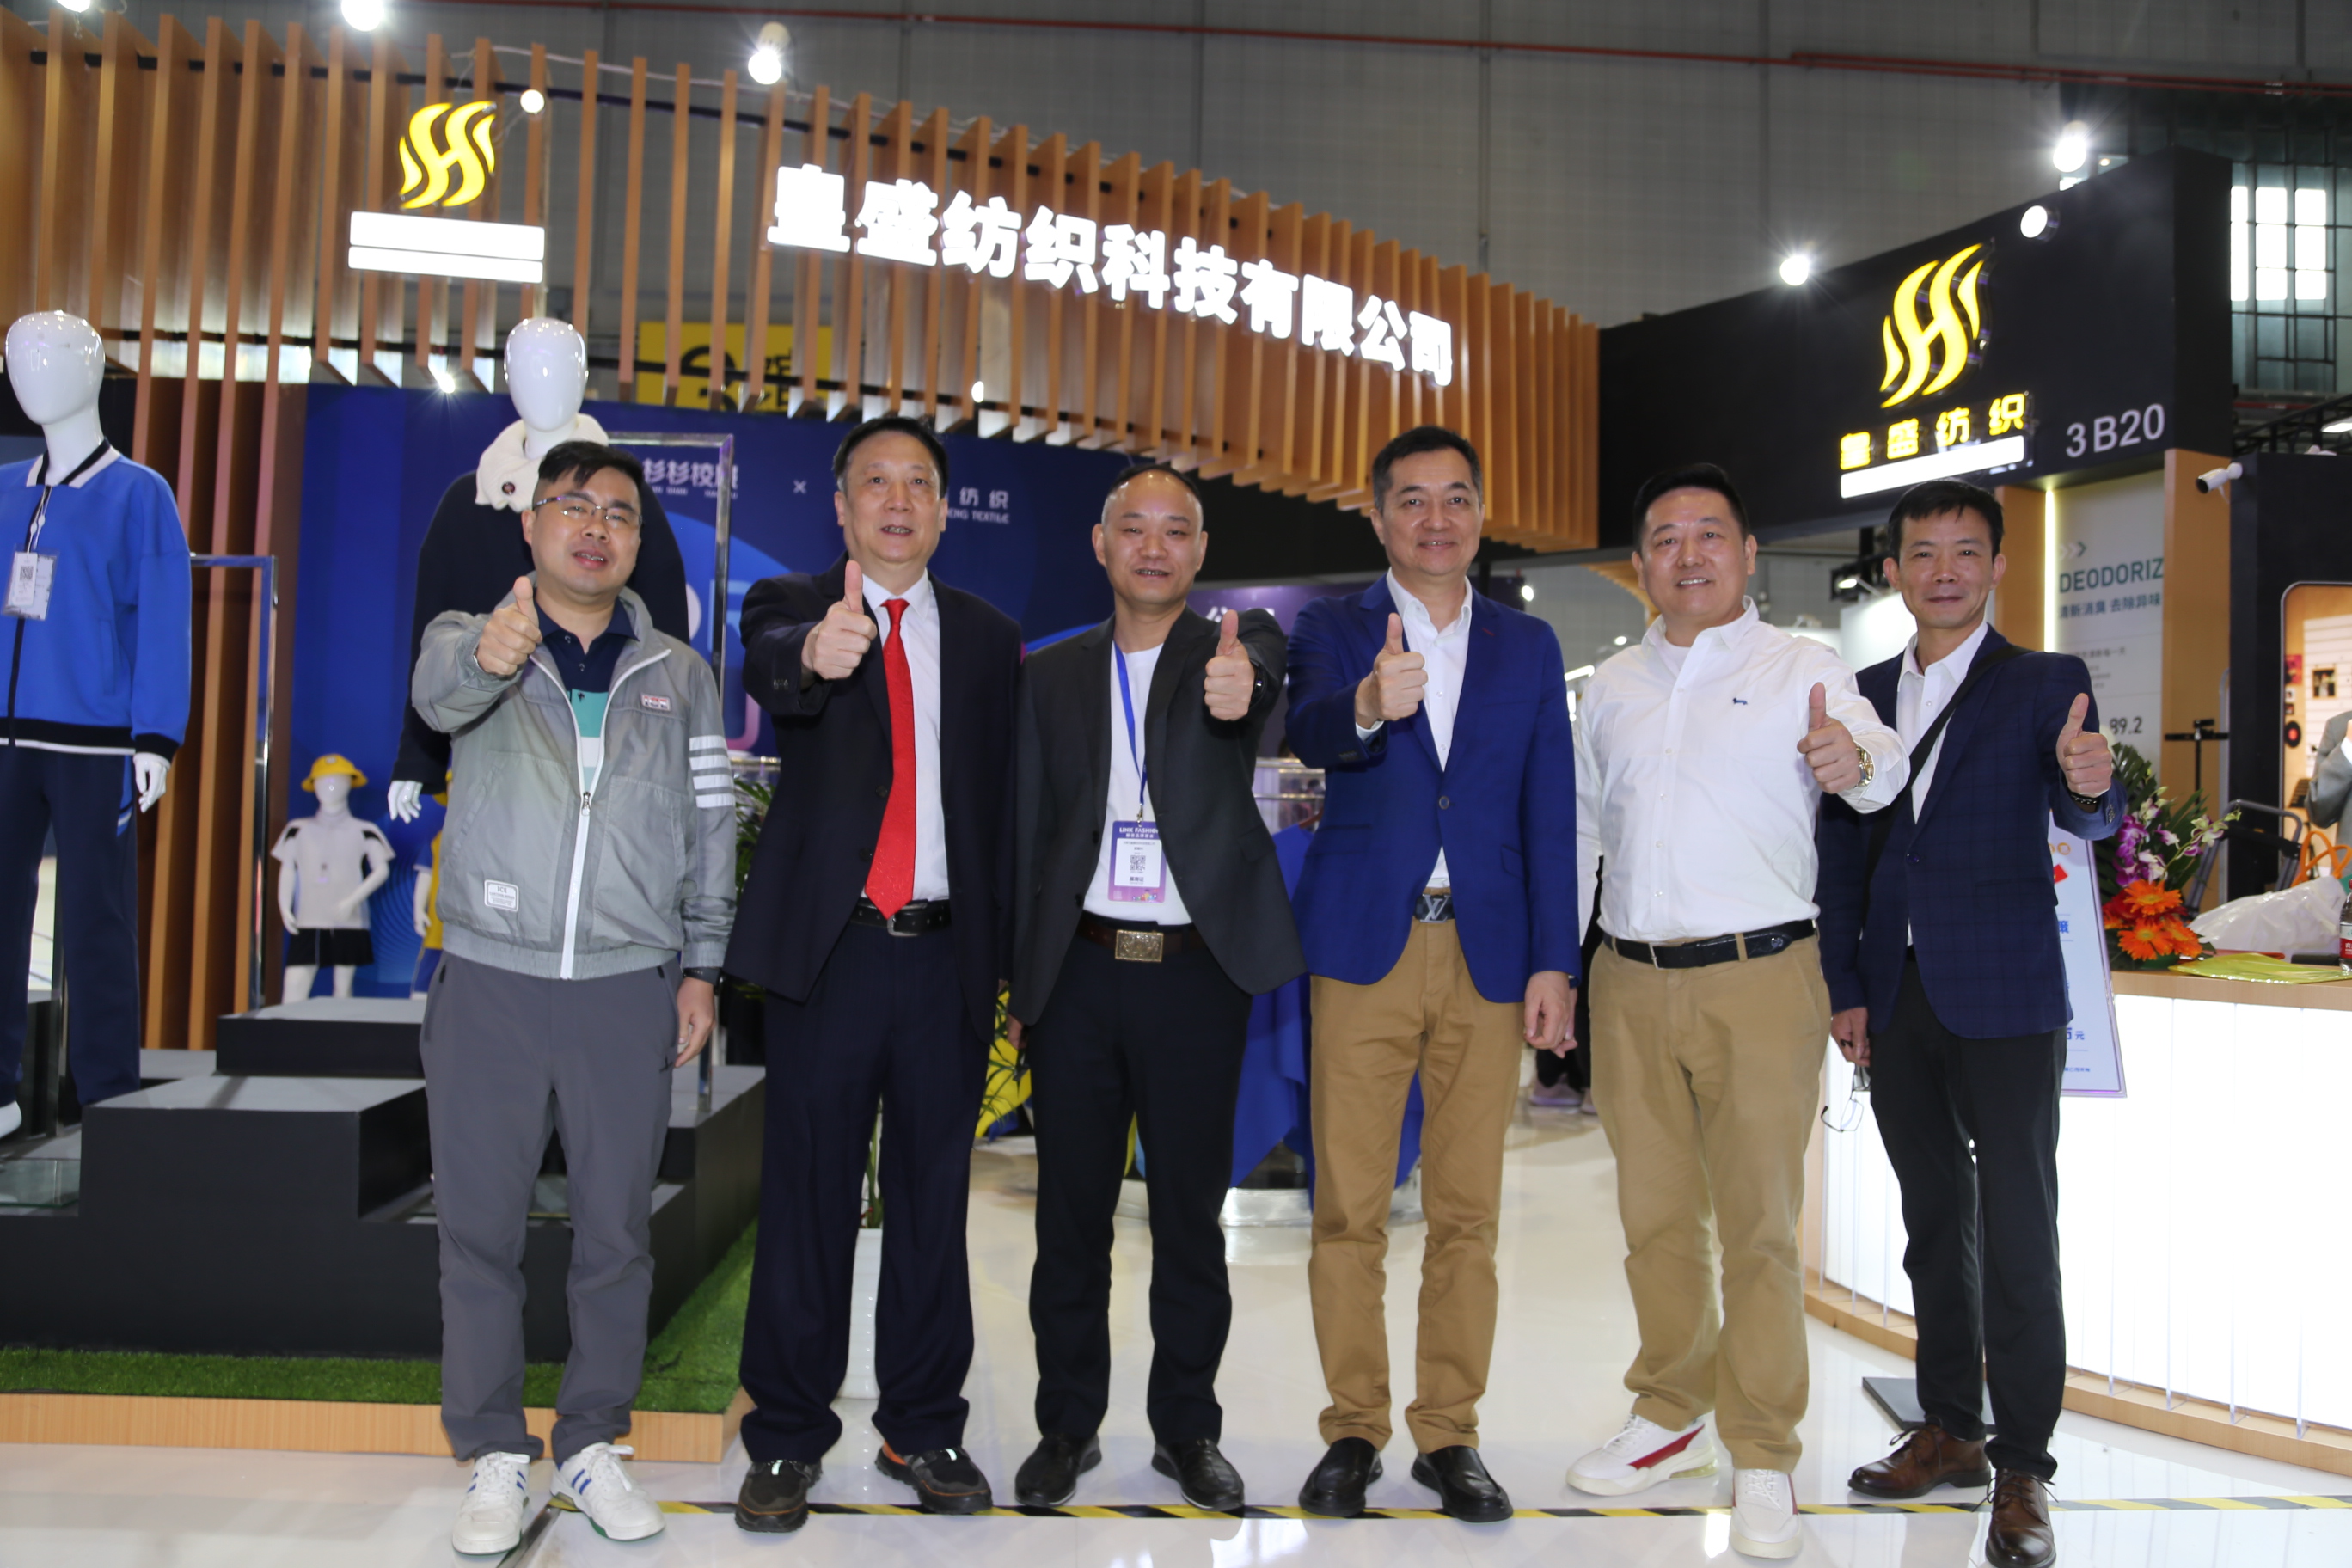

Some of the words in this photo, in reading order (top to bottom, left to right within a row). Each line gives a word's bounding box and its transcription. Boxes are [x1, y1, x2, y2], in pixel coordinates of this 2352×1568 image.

[1840, 393, 2025, 470] 皇盛纺织
[2066, 404, 2165, 458] 3B20
[946, 487, 1009, 510] 纺织
